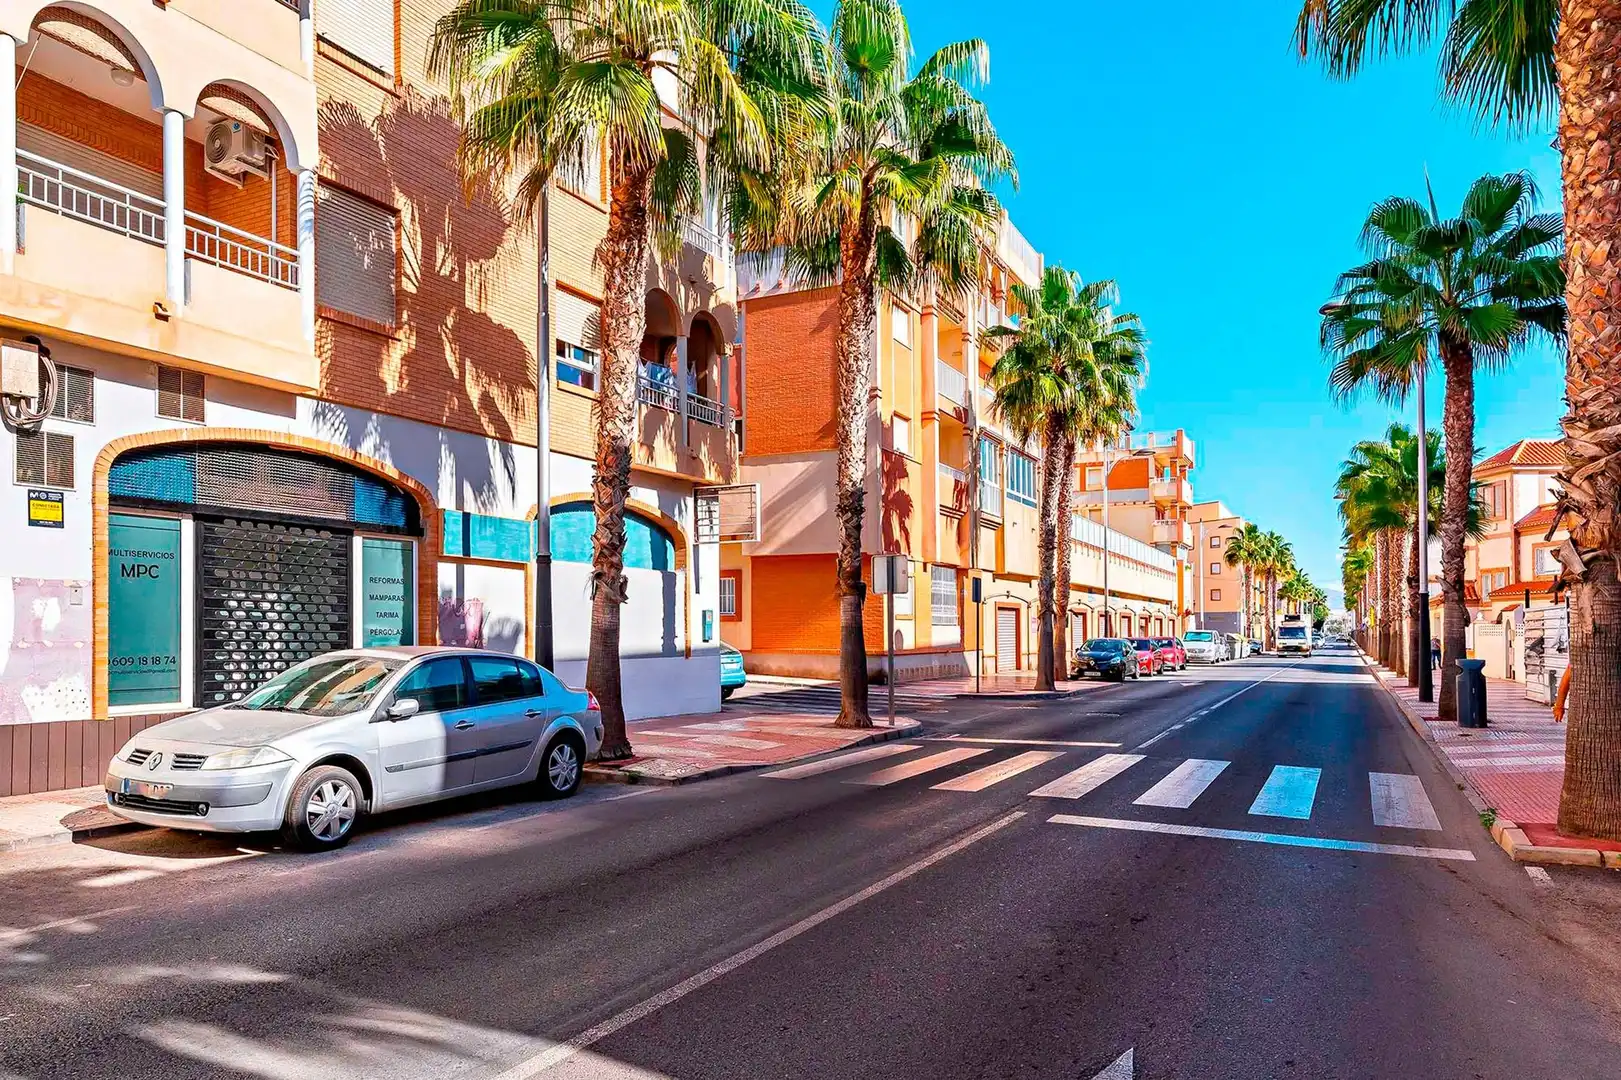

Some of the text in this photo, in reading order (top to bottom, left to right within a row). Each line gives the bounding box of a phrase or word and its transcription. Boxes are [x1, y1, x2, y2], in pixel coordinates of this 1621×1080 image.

[108, 549, 175, 559] MULTISERVICIOS
[121, 563, 160, 579] MPC
[369, 577, 405, 585] REFORMAS
[111, 656, 177, 667] 609 18 18 74
